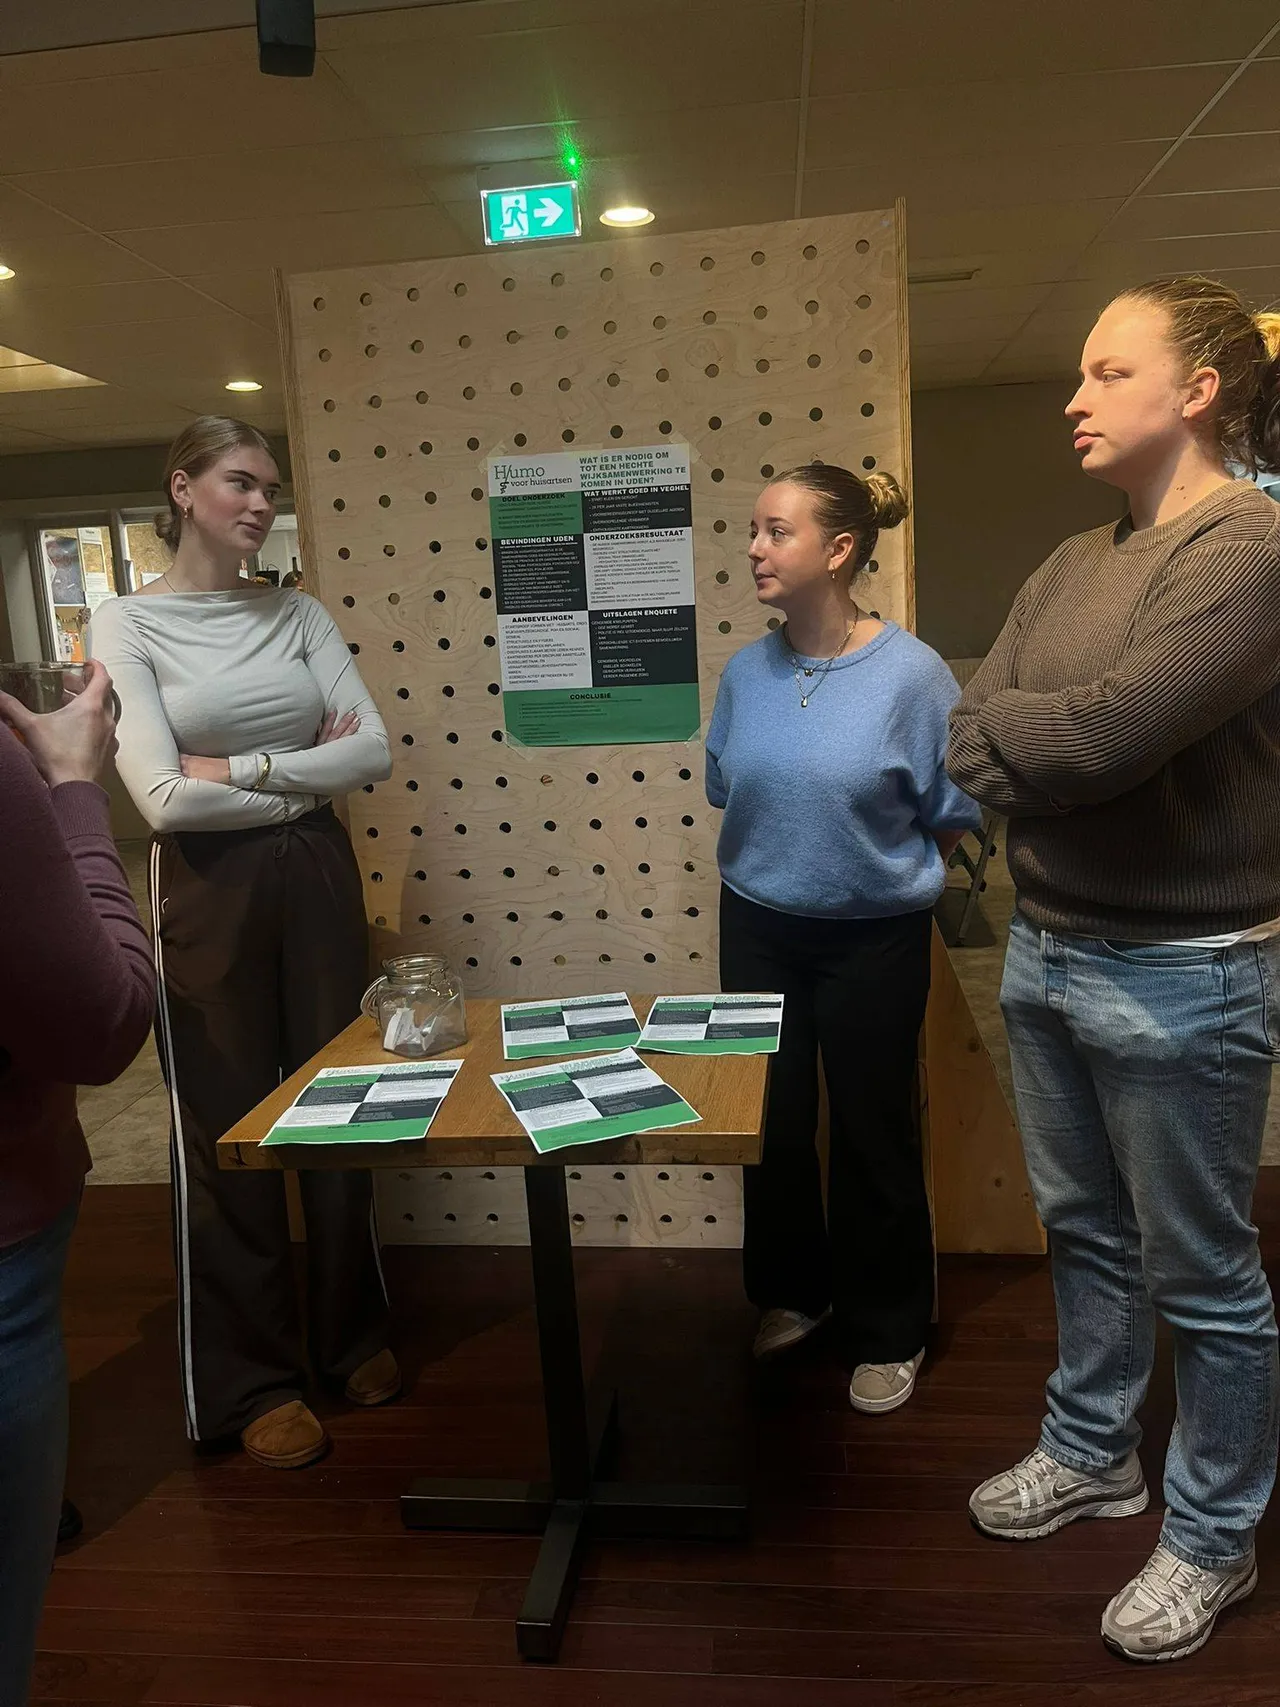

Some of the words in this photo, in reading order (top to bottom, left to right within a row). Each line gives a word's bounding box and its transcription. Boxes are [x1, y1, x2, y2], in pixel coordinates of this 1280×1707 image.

[626, 453, 653, 461] NODIG
[600, 463, 616, 471] EEN
[620, 461, 654, 469] HECHTE
[580, 467, 672, 480] WIJKSAMENWERKING
[530, 477, 572, 486] huisartsen
[581, 480, 612, 488] KOMEN
[626, 477, 654, 485] UDEN?
[589, 530, 684, 541] ONDERZOEKSRESULTAAT
[501, 537, 551, 545] BEVINDINGEN
[512, 615, 573, 623] AANBEVELINGEN
